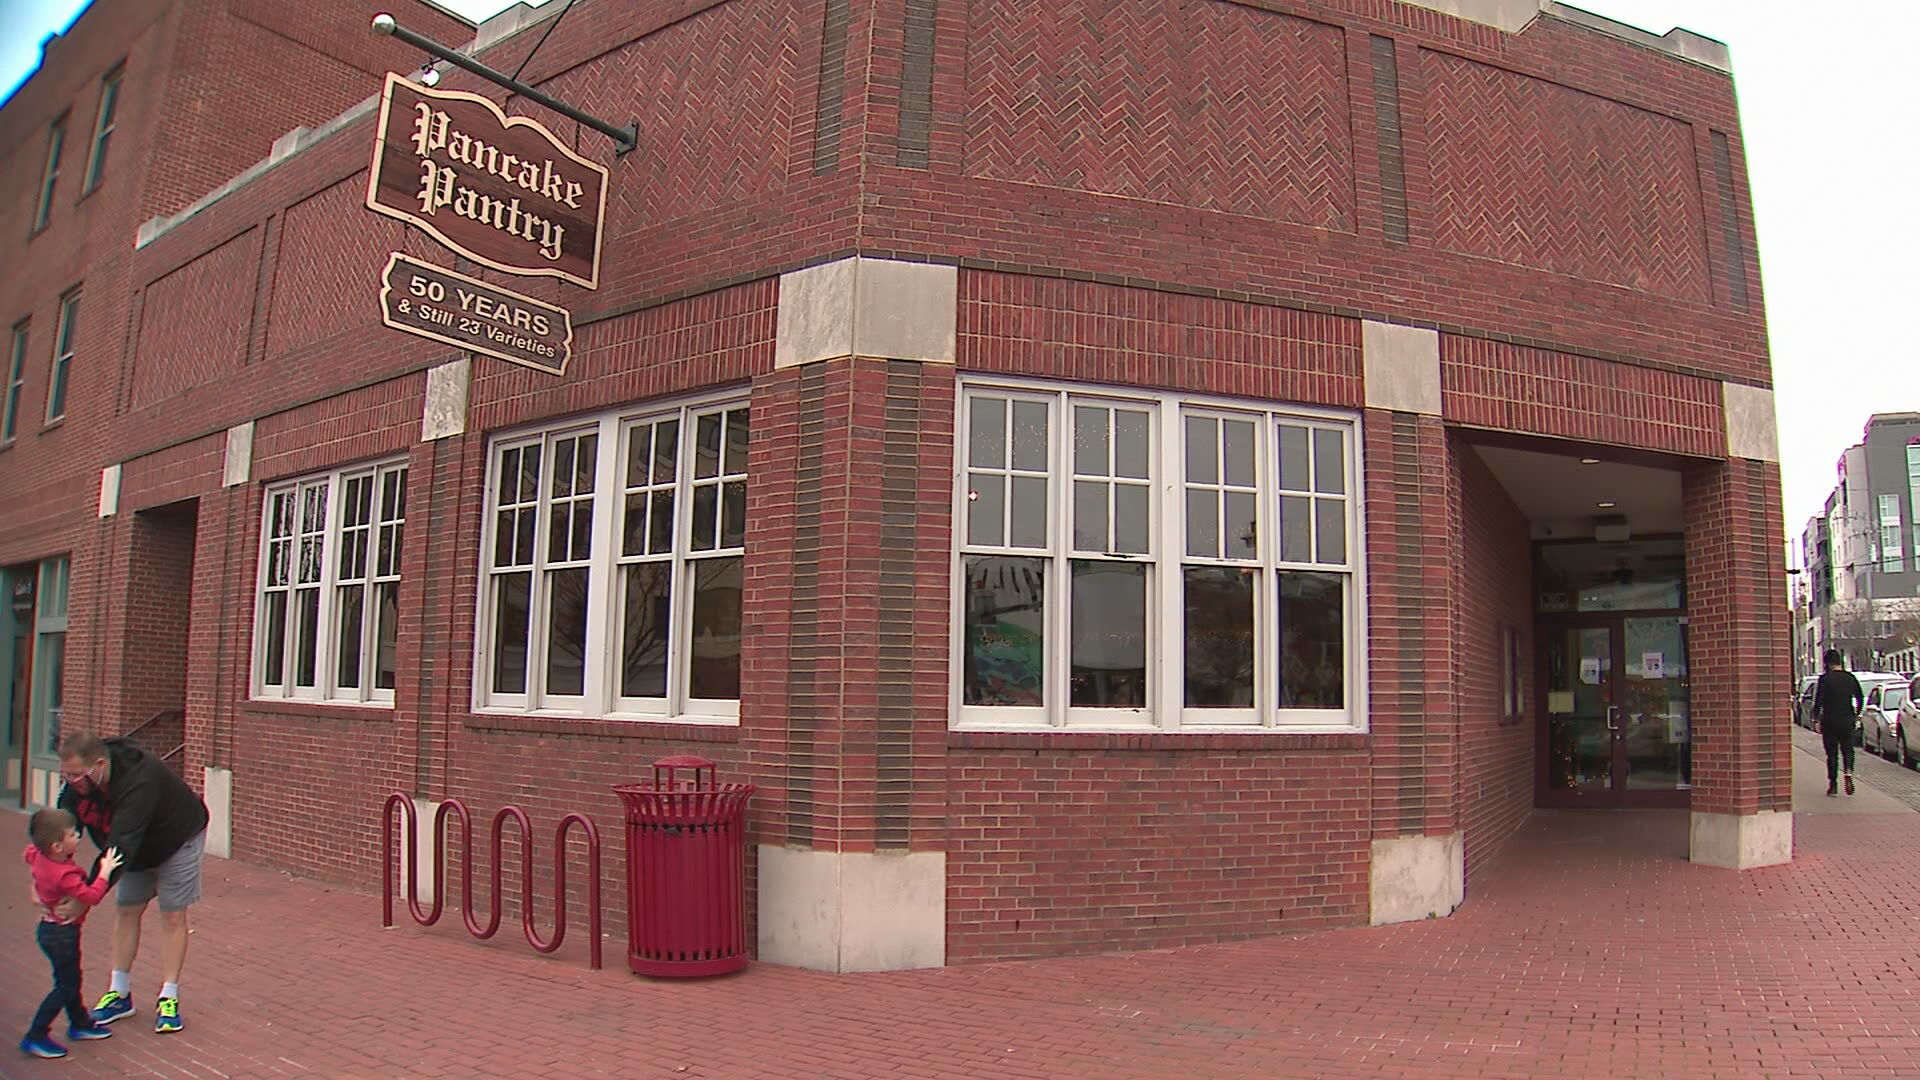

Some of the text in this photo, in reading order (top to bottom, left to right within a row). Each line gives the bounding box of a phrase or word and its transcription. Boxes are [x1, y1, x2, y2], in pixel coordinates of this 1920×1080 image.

[411, 102, 584, 210] Pancake
[417, 159, 565, 260] Pantry
[397, 300, 555, 358] & Still 23 Varieties
[410, 276, 550, 336] 50 YEARS
